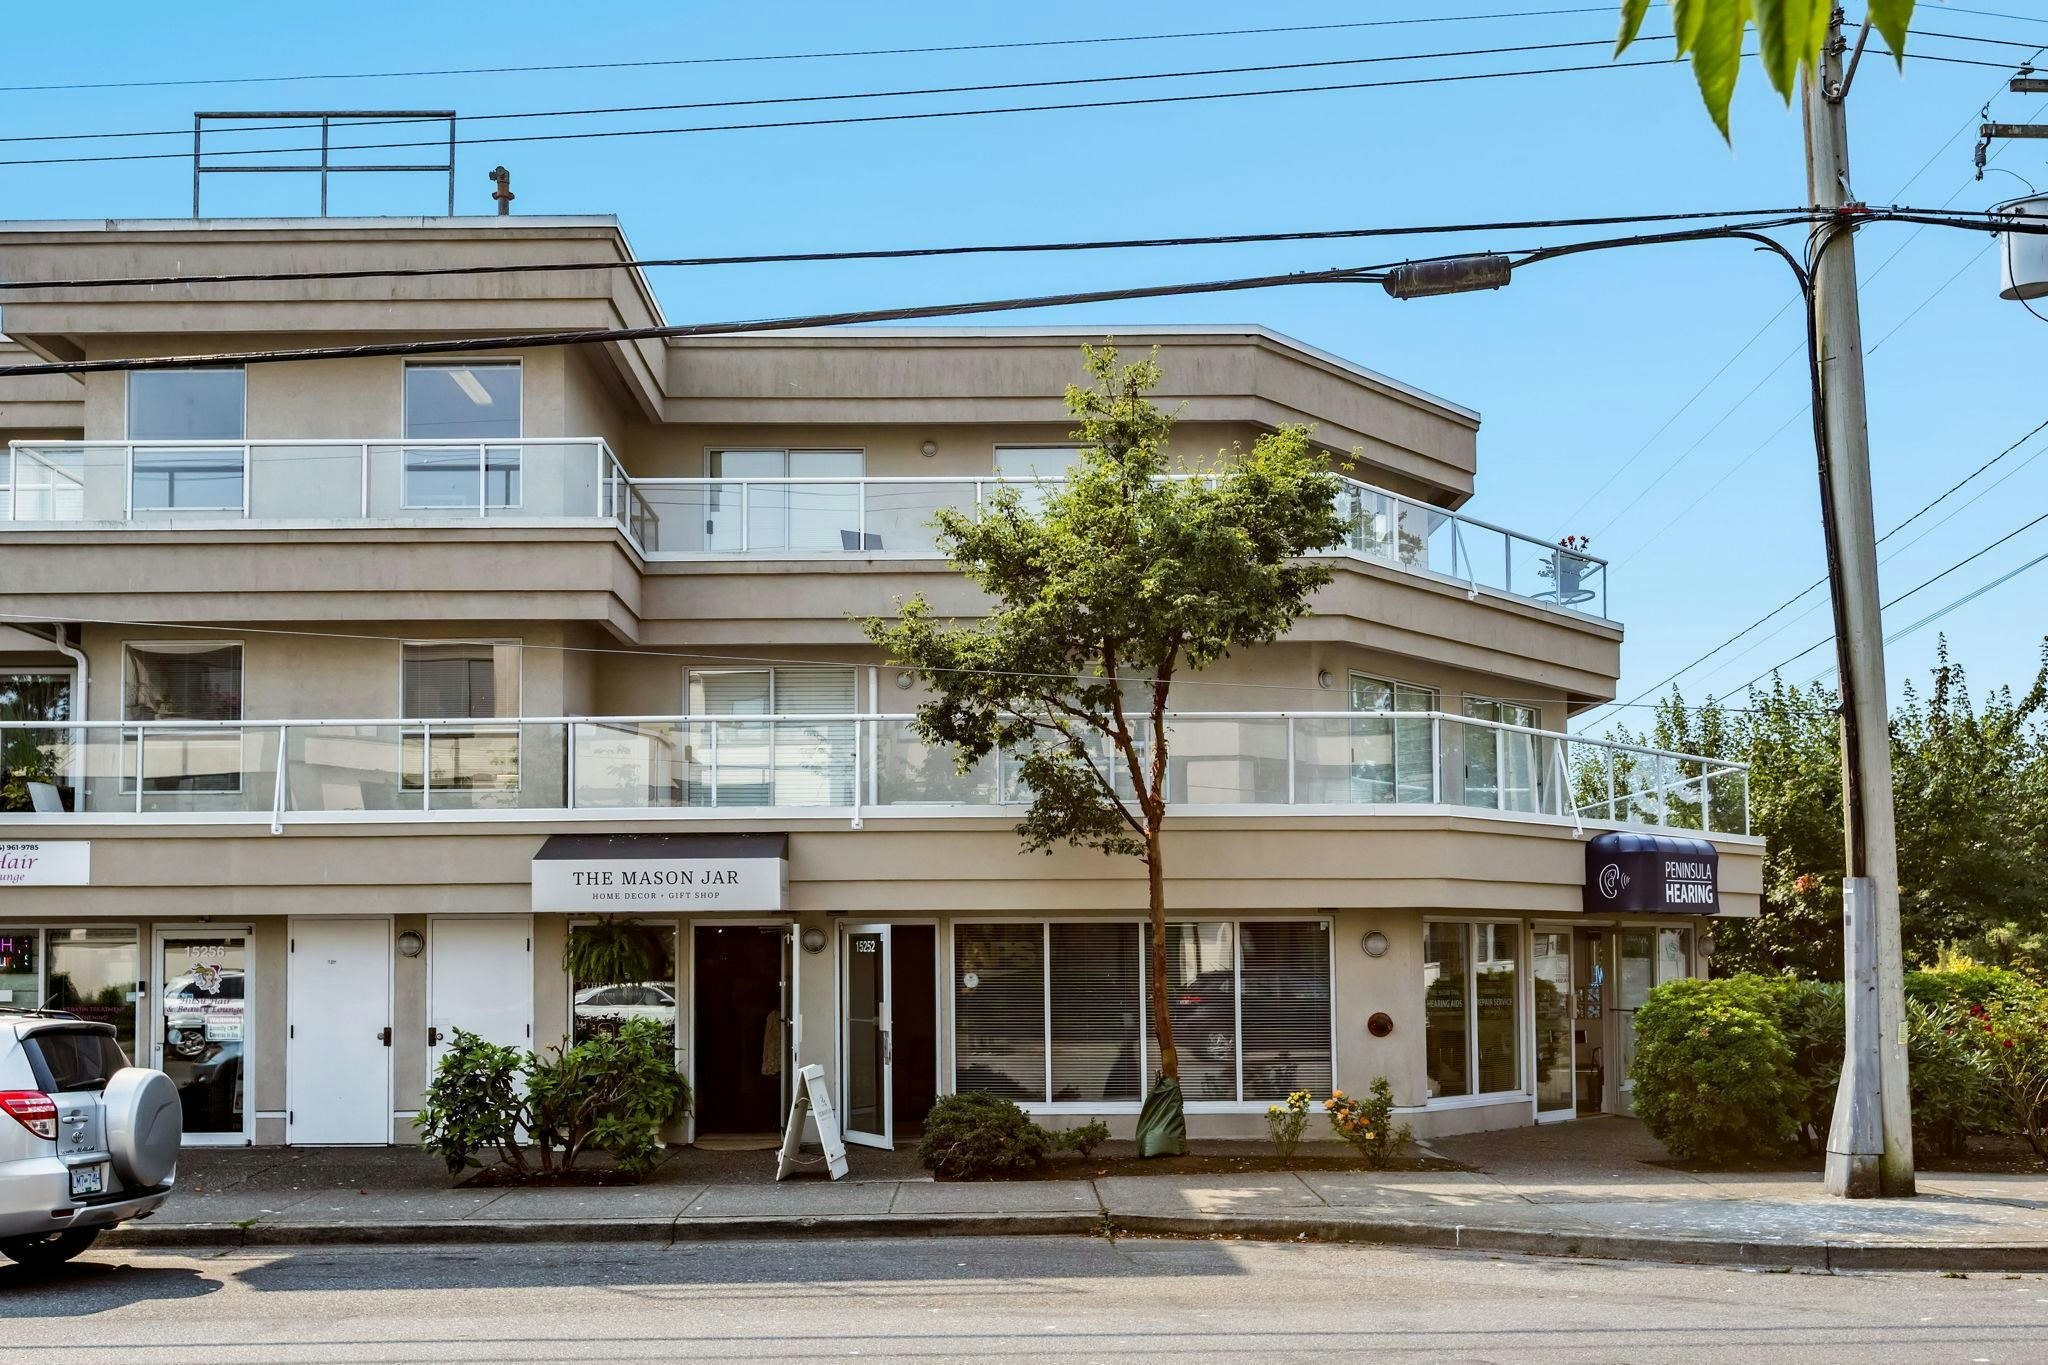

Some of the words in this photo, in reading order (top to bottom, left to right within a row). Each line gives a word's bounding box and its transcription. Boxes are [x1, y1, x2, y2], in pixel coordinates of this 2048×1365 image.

[1665, 861, 1712, 880] PENINSULA
[573, 871, 613, 886] THE
[621, 870, 694, 885] MASON
[701, 870, 739, 885] JAR
[592, 892, 621, 900] HOME
[624, 892, 657, 900] DECOR
[668, 891, 691, 899] GIFT
[694, 891, 720, 899] SHOP
[1665, 883, 1714, 904] HEARING
[184, 946, 225, 958] 15256
[856, 940, 876, 953] 15252
[1426, 999, 1450, 1008] HEARING
[1451, 999, 1463, 1008] AIDS
[177, 1005, 209, 1015] Beauty
